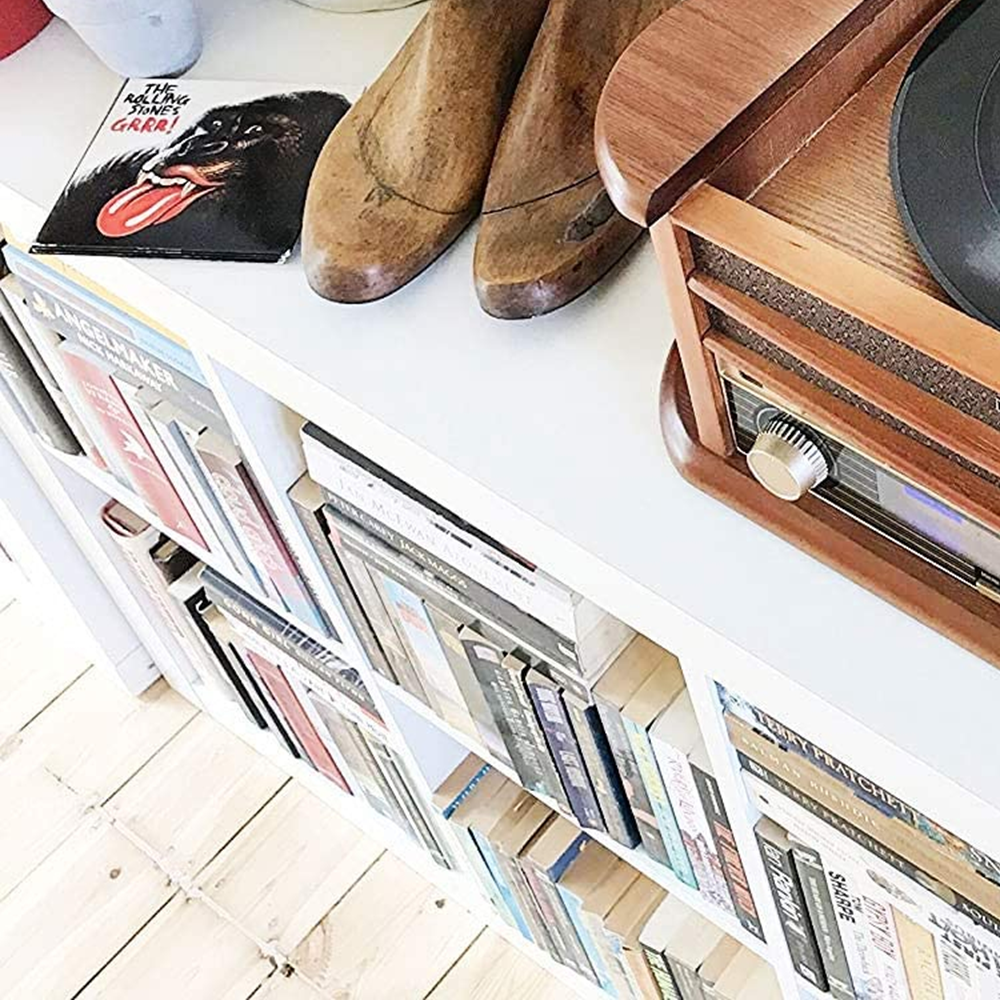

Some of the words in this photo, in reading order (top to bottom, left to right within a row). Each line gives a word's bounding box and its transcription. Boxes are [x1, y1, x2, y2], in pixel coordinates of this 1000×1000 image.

[123, 92, 191, 106] ROLLING
[145, 82, 179, 94] THE
[110, 115, 180, 135] GRRR!
[127, 104, 181, 116] STONES
[54, 302, 179, 391] ANGELMAKER
[77, 331, 107, 356] NICK
[742, 737, 801, 779] SALMAN
[755, 708, 809, 753] TERRY
[813, 745, 922, 829] PRATCHETT
[776, 779, 819, 812] TERRY
[823, 809, 905, 869] PRATCHETT
[764, 842, 785, 867] Ian
[769, 866, 803, 922] Rankin
[828, 870, 856, 925] SHARPE
